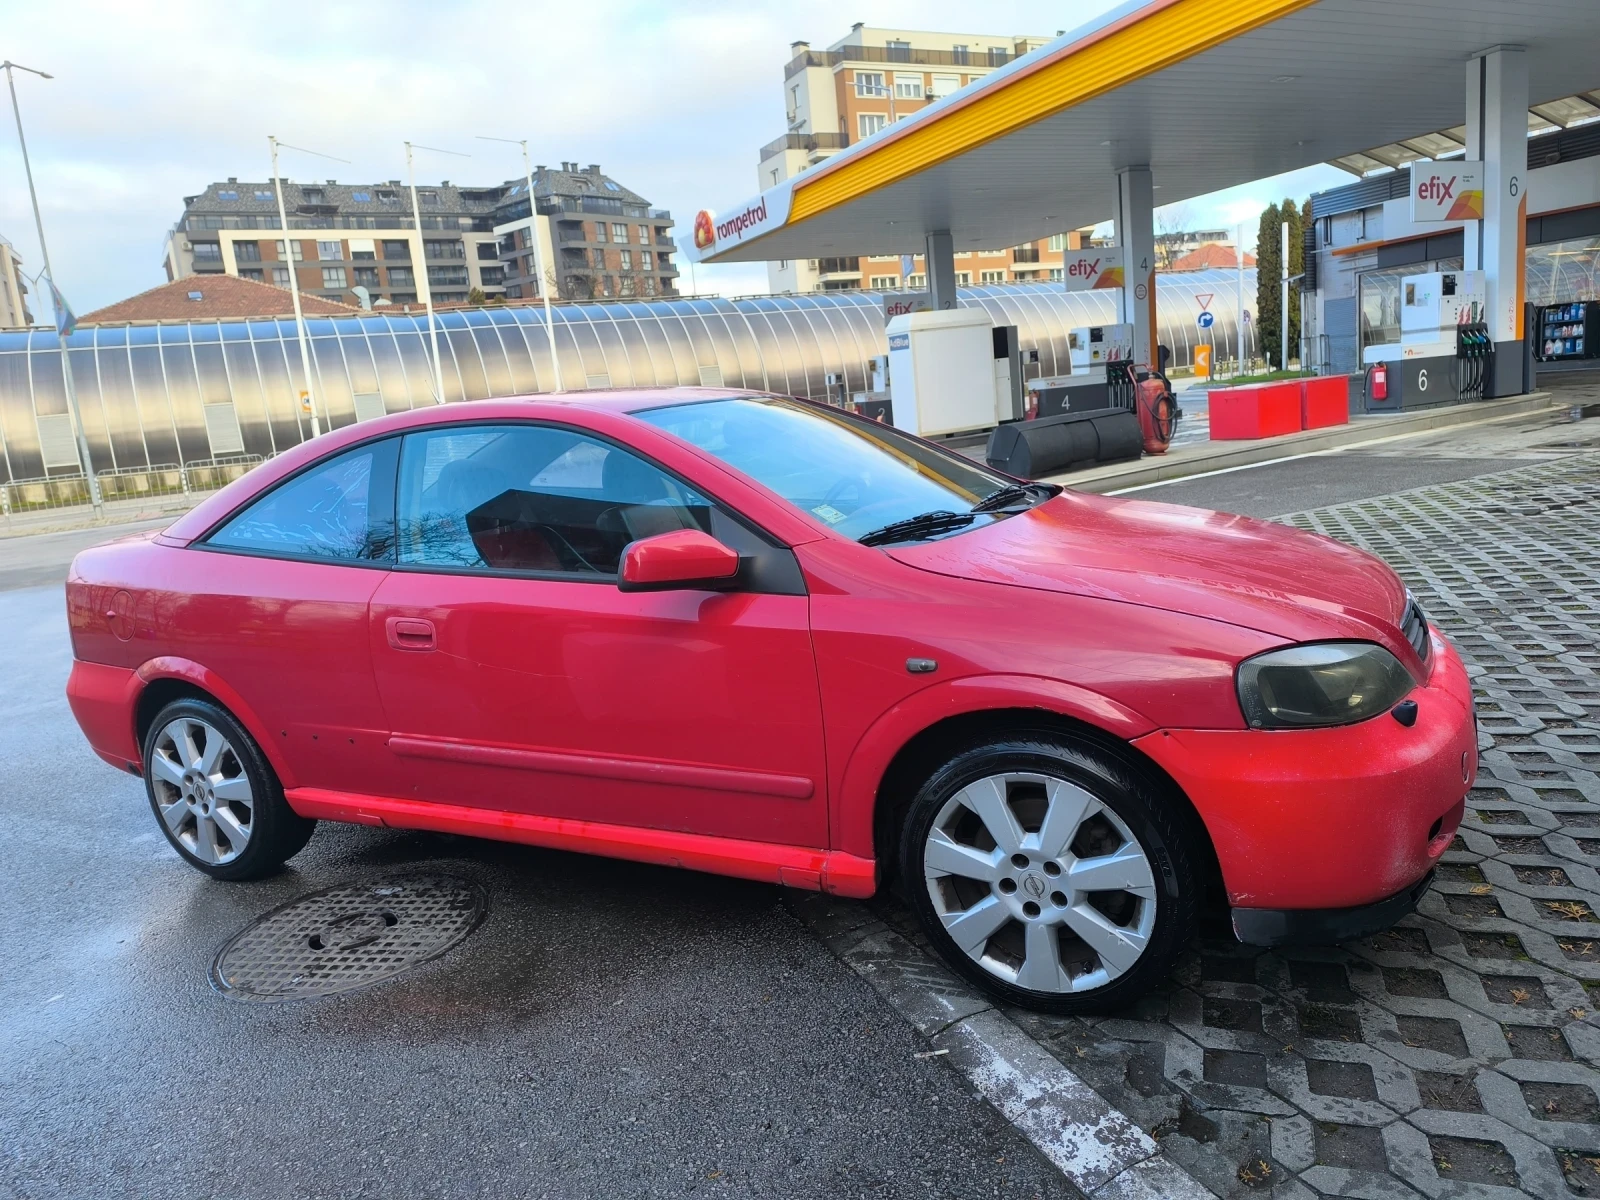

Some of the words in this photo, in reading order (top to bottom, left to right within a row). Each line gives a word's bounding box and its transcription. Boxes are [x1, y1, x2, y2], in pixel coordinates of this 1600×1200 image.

[1418, 175, 1457, 206] efix
[1509, 176, 1519, 197] 6
[716, 195, 767, 240] rompetrol
[1068, 258, 1100, 280] efix
[1140, 257, 1148, 272] 4
[887, 301, 913, 316] efix
[890, 336, 909, 348] AdBlue
[1418, 369, 1428, 391] 6
[1061, 395, 1070, 410] 4
